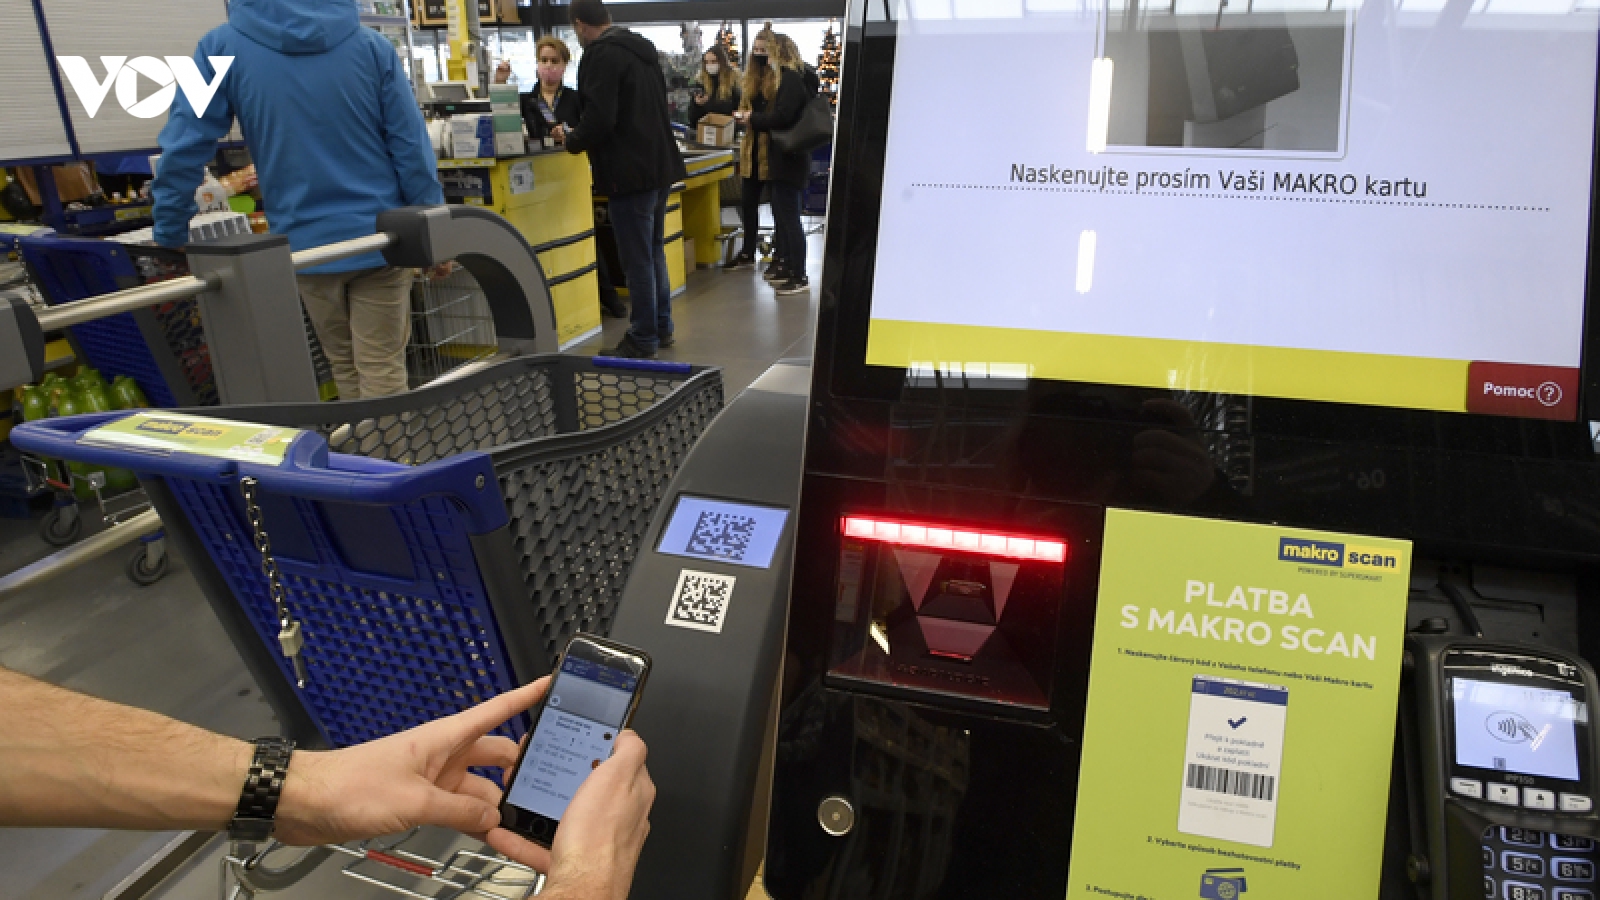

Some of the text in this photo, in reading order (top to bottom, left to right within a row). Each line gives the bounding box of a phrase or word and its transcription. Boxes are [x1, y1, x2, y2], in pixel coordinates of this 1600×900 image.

[1010, 163, 1428, 198] Naskenujte prosím Vaši MAKRO kartu
[1483, 382, 1534, 401] Pomoc
[1284, 542, 1397, 569] makro scan
[1185, 580, 1314, 619] PLATBA
[1120, 605, 1377, 661] S MAKRO SCAN
[1323, 675, 1349, 687] Makro
